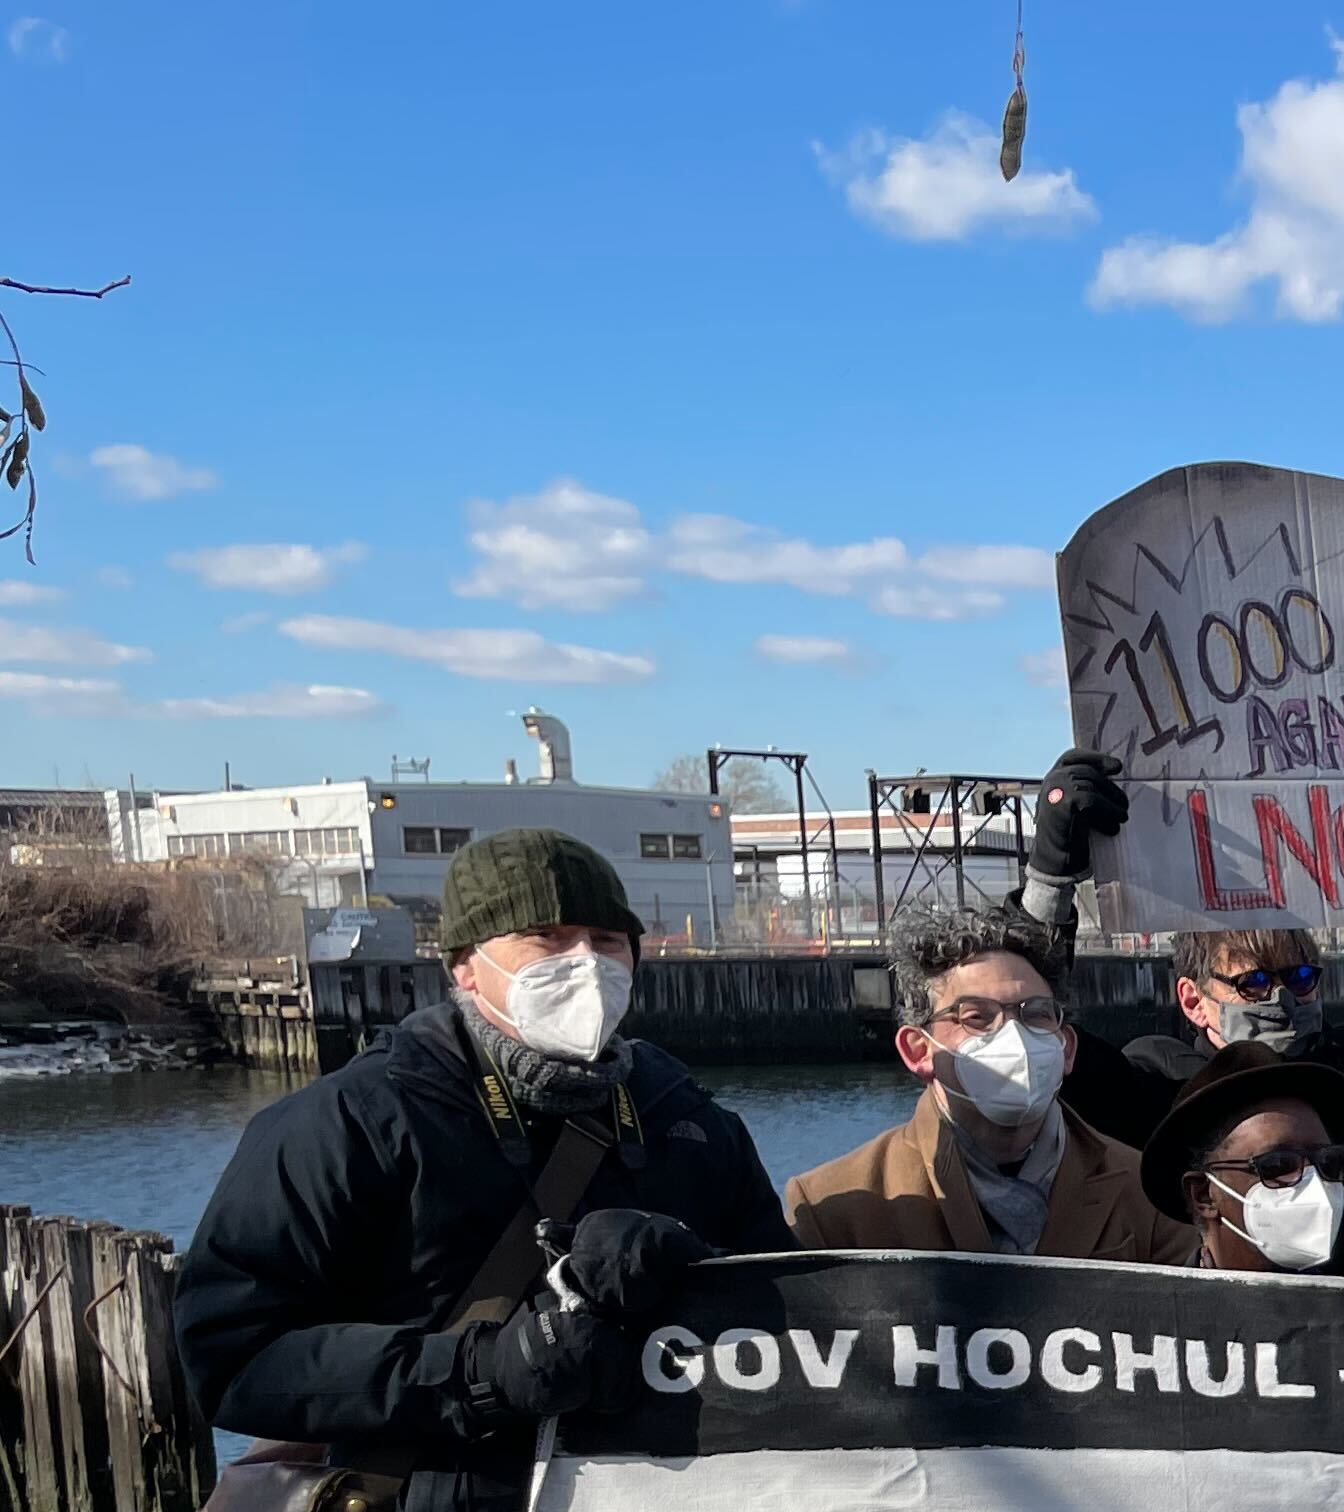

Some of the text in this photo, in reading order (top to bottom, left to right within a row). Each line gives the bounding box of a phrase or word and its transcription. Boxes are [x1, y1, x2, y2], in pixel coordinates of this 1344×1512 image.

[483, 1075, 512, 1119] Nikon
[640, 1324, 859, 1393] GOV
[892, 1325, 1317, 1399] HOCHUL
